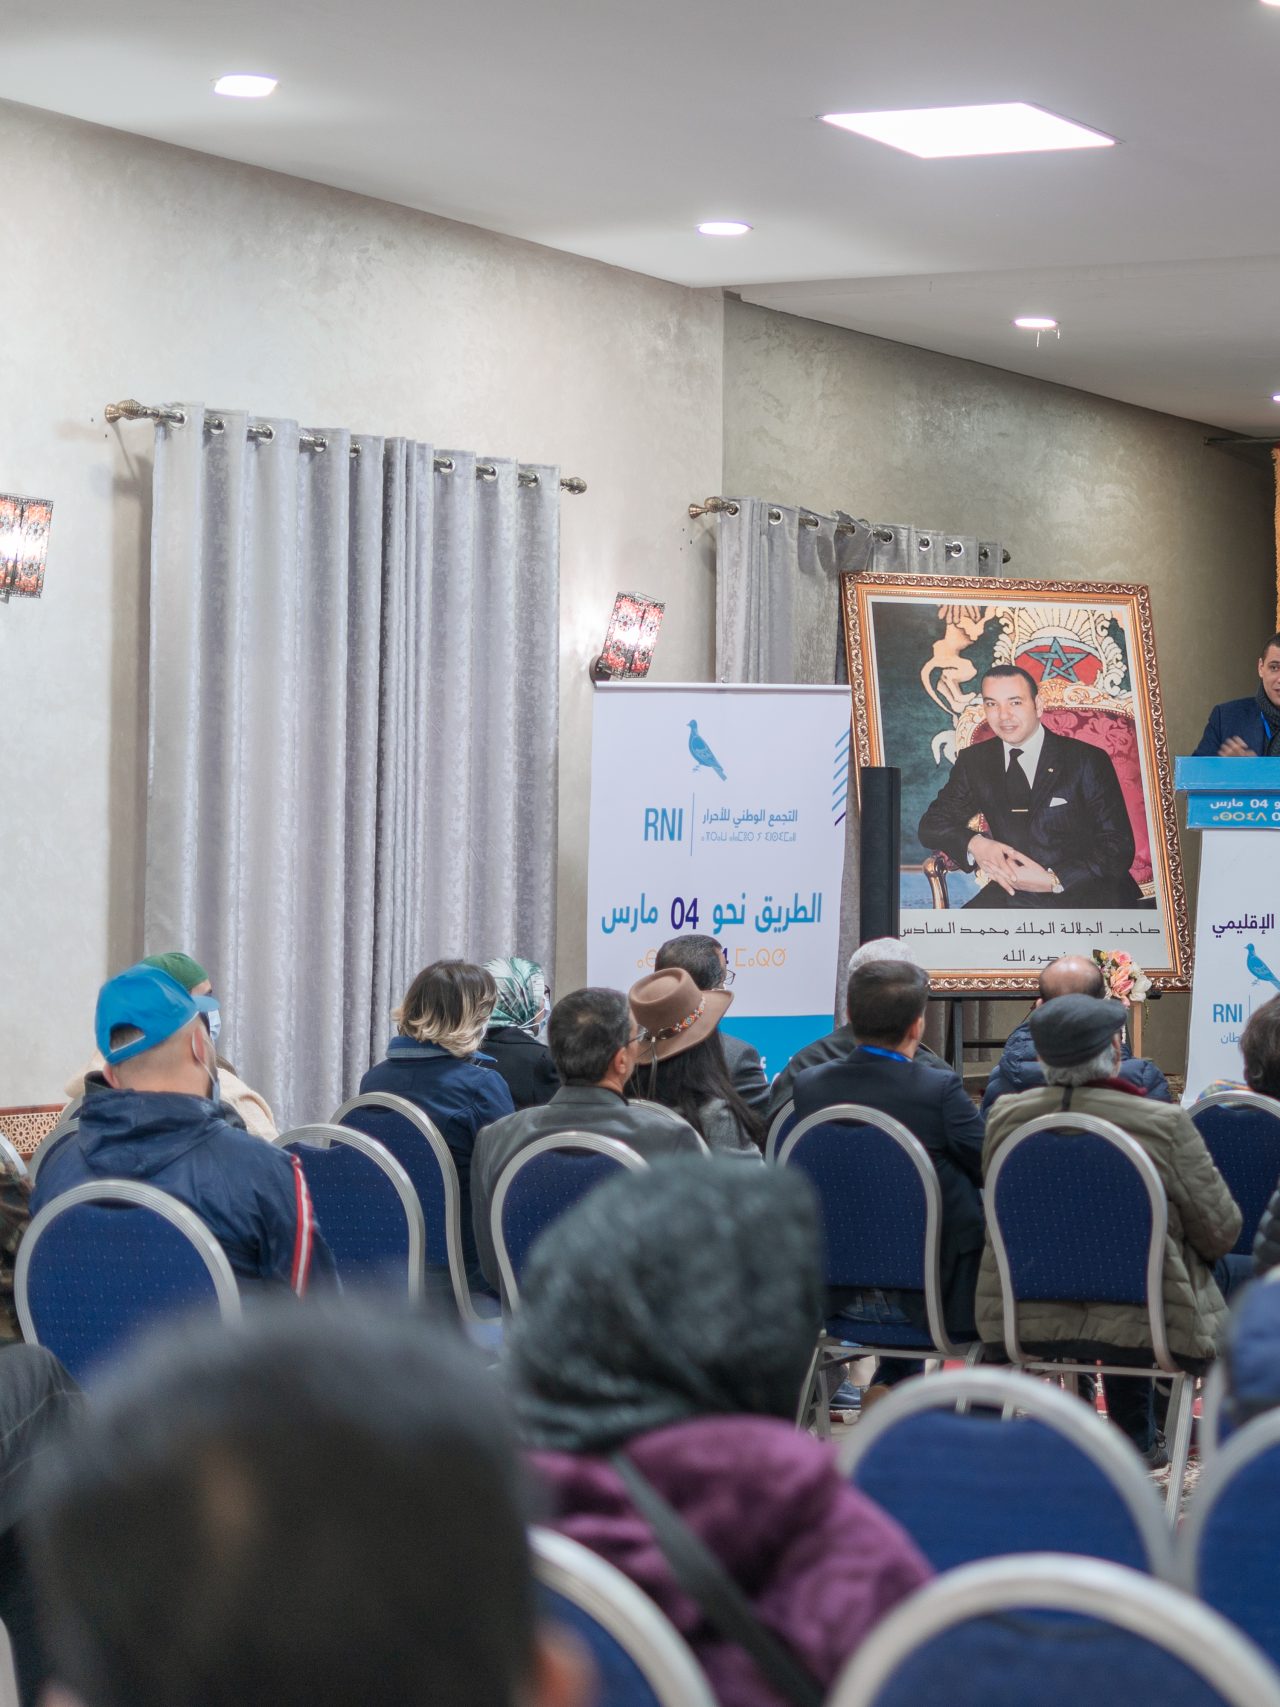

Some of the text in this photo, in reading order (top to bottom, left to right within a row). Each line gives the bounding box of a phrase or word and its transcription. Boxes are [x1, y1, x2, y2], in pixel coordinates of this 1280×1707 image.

[1210, 798, 1244, 809] مارس
[1250, 799, 1268, 808] 04
[644, 808, 683, 841] RNI
[702, 807, 798, 828] التجمع الوطني للأحرار
[601, 893, 823, 935] الطريق نحو 04 مارس
[899, 921, 1161, 937] صاحب الجلالة الملك محمد السادس
[1211, 913, 1275, 938] الإقليمي
[1003, 949, 1026, 961] الله
[1213, 1003, 1242, 1023] RNI
